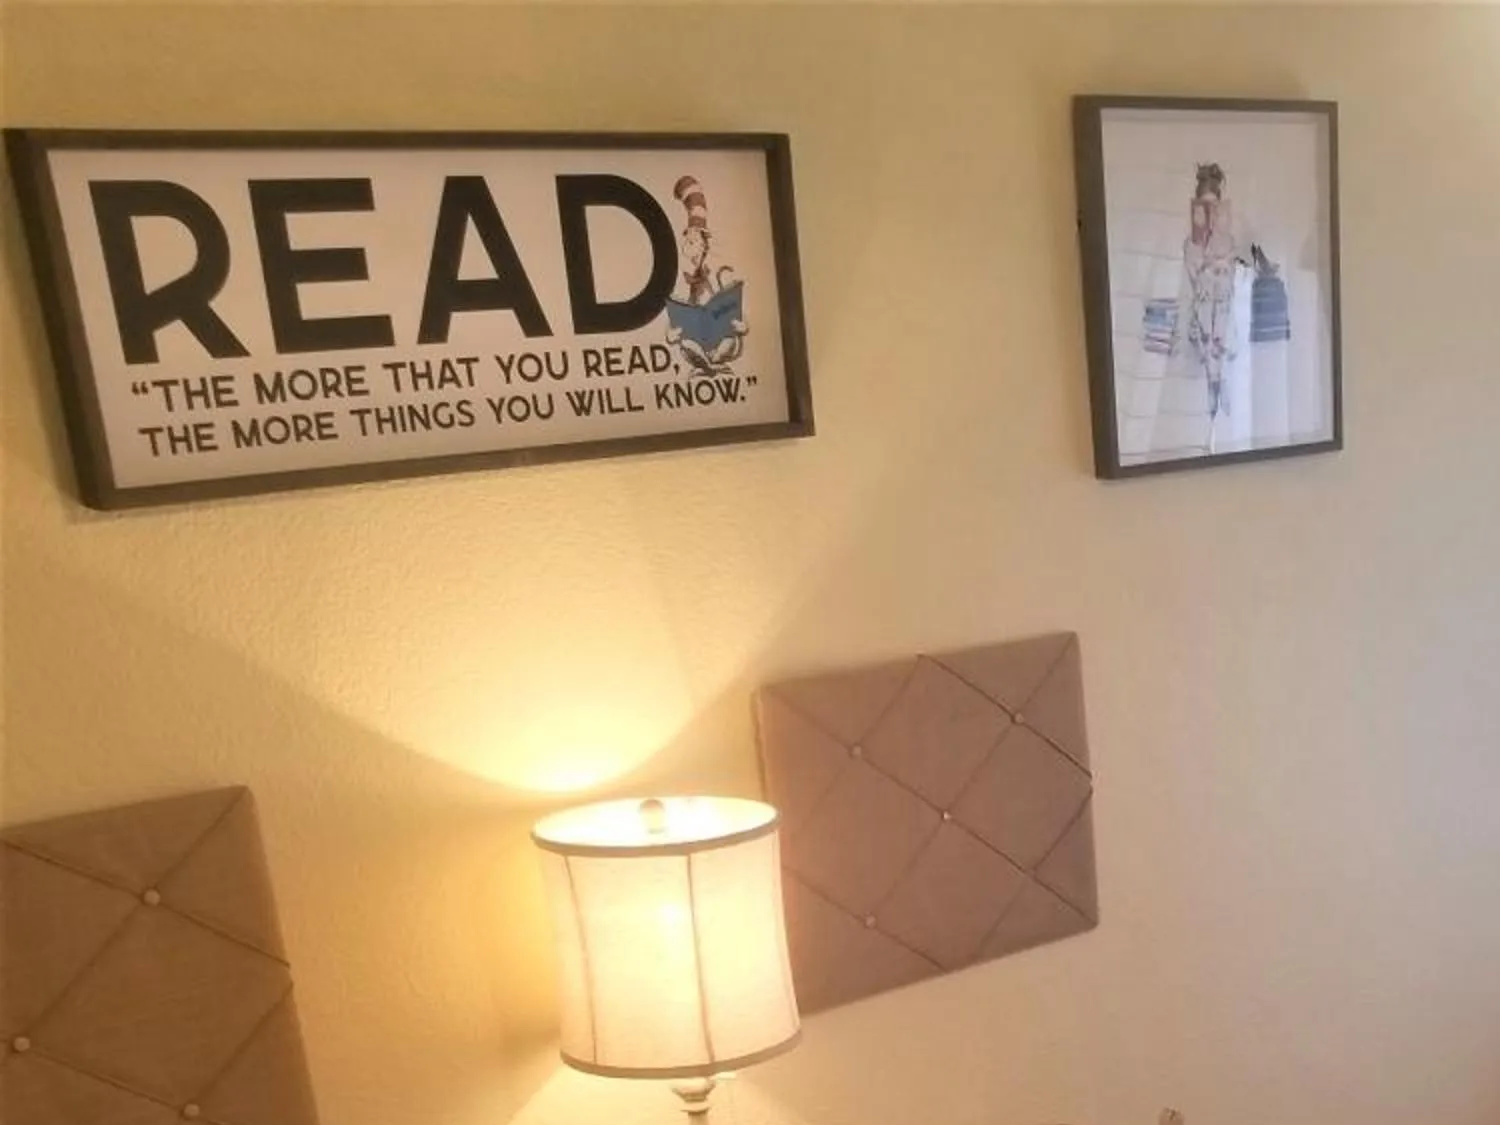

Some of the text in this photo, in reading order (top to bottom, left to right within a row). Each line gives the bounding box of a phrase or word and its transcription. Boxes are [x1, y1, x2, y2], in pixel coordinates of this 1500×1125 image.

[88, 173, 680, 365] READ
[131, 343, 681, 413] “THE MORE THAT YOU READ,
[138, 375, 758, 457] THE MORE THINGS YOU WILL KNOW.”
